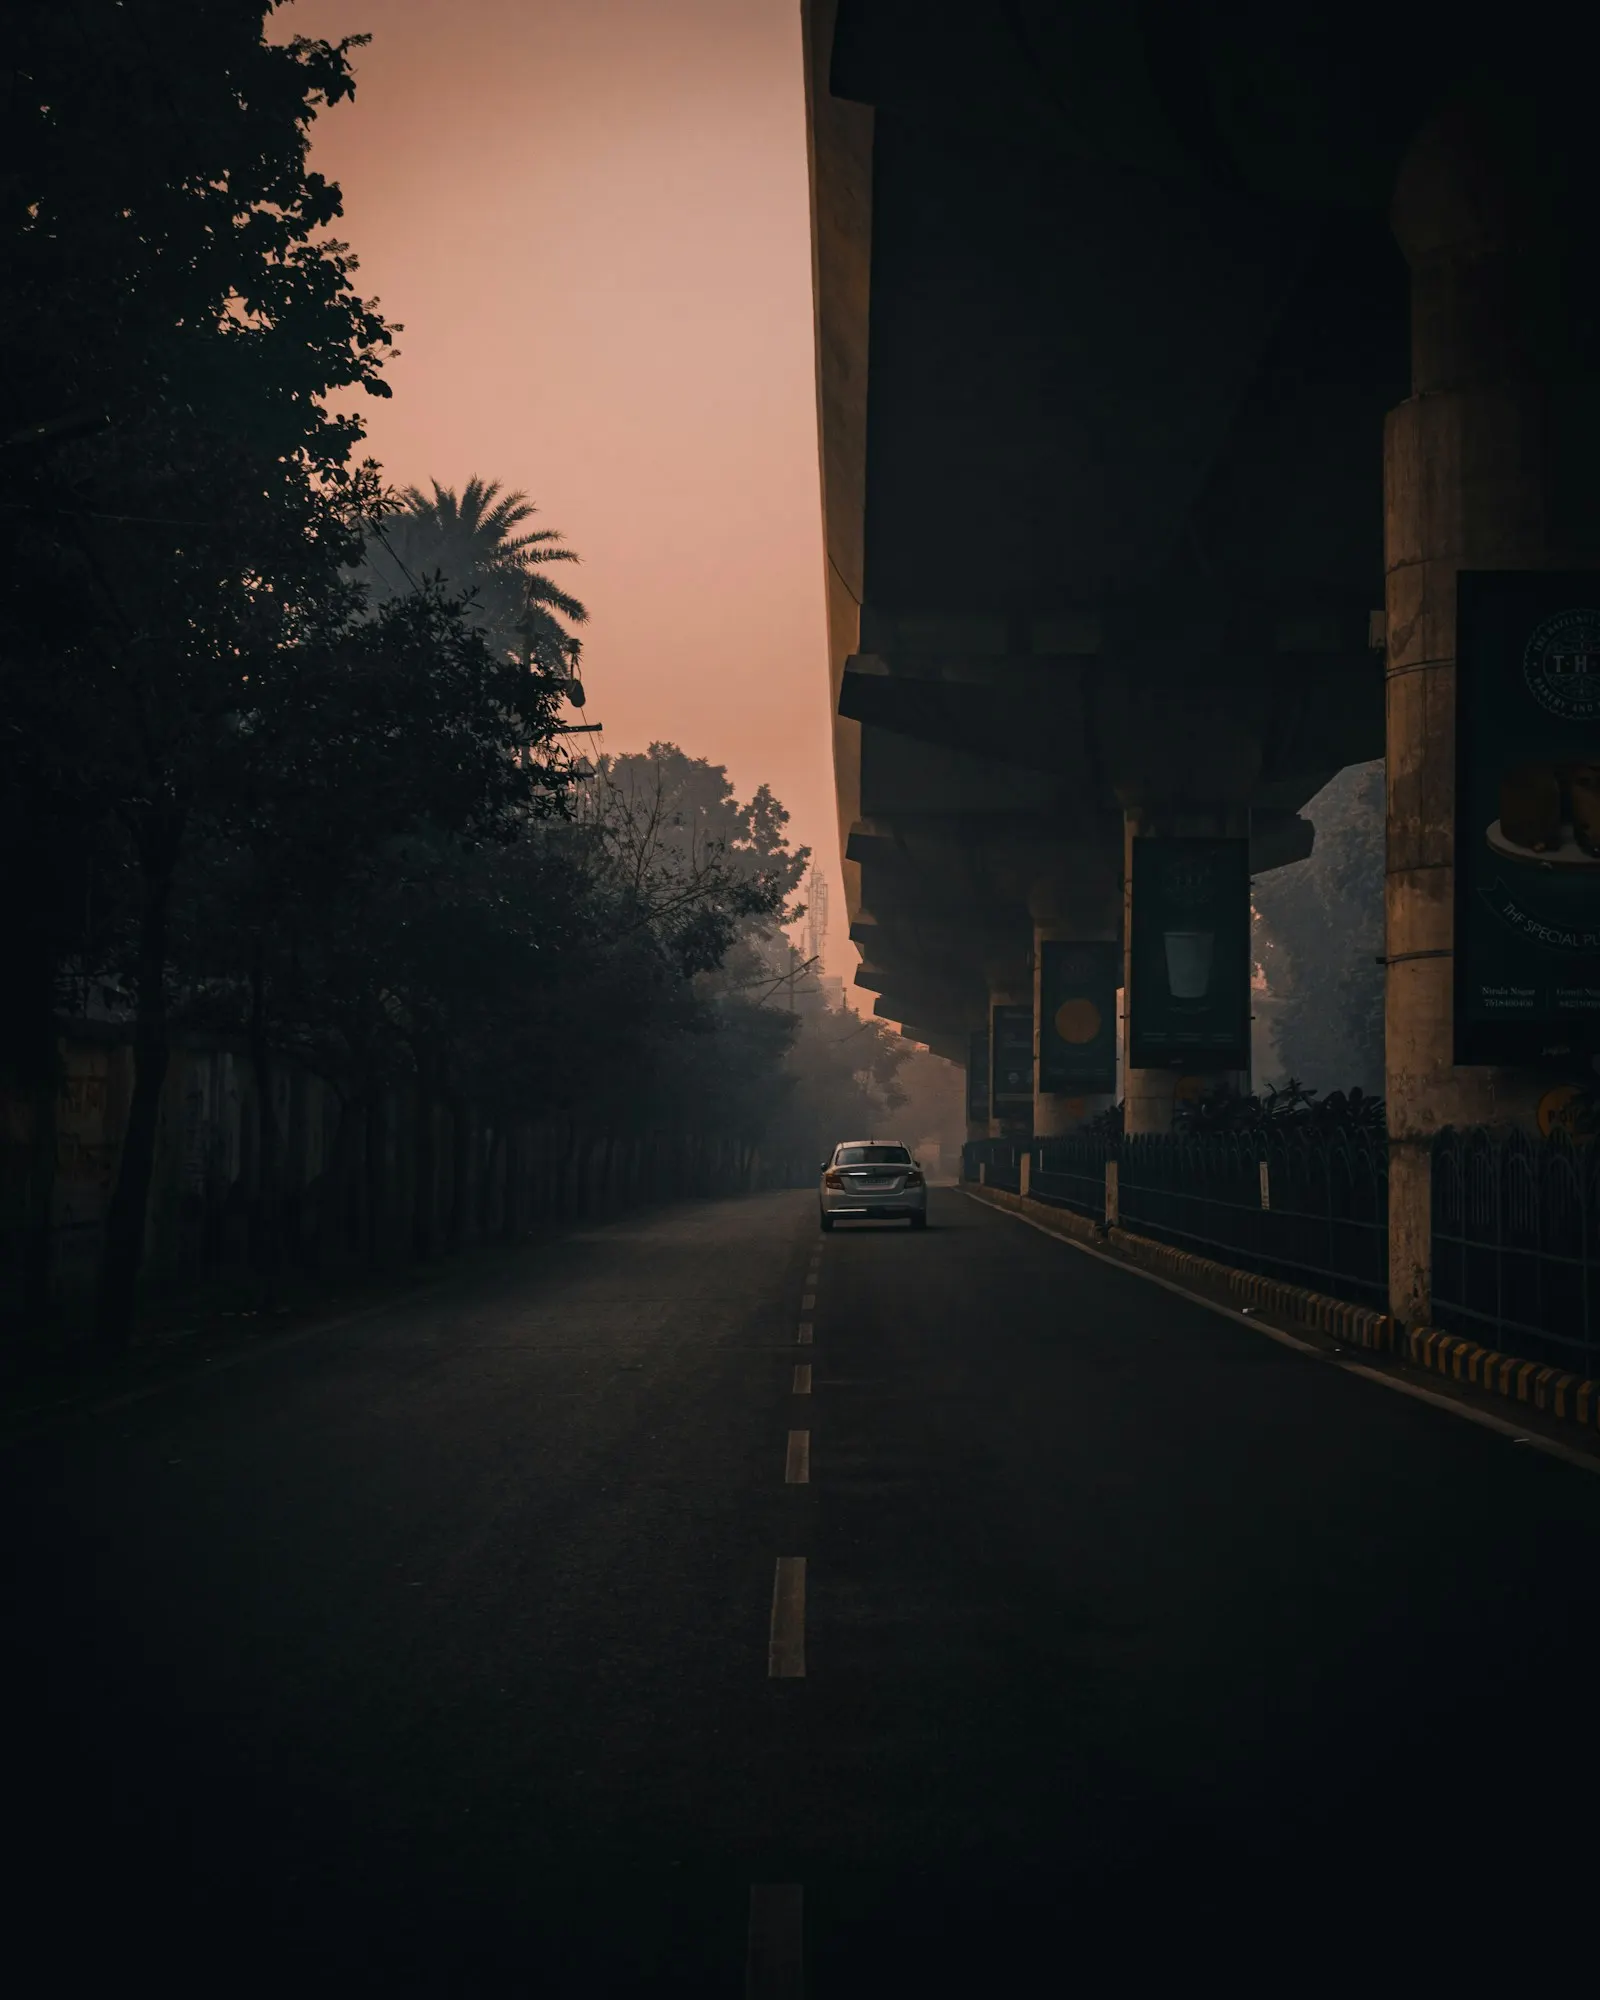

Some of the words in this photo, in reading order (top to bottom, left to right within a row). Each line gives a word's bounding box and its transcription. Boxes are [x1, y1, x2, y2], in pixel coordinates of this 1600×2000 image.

[1502, 901, 1527, 923] THE
[1523, 919, 1579, 947] SPECIAL
[1581, 933, 1600, 947] PL
